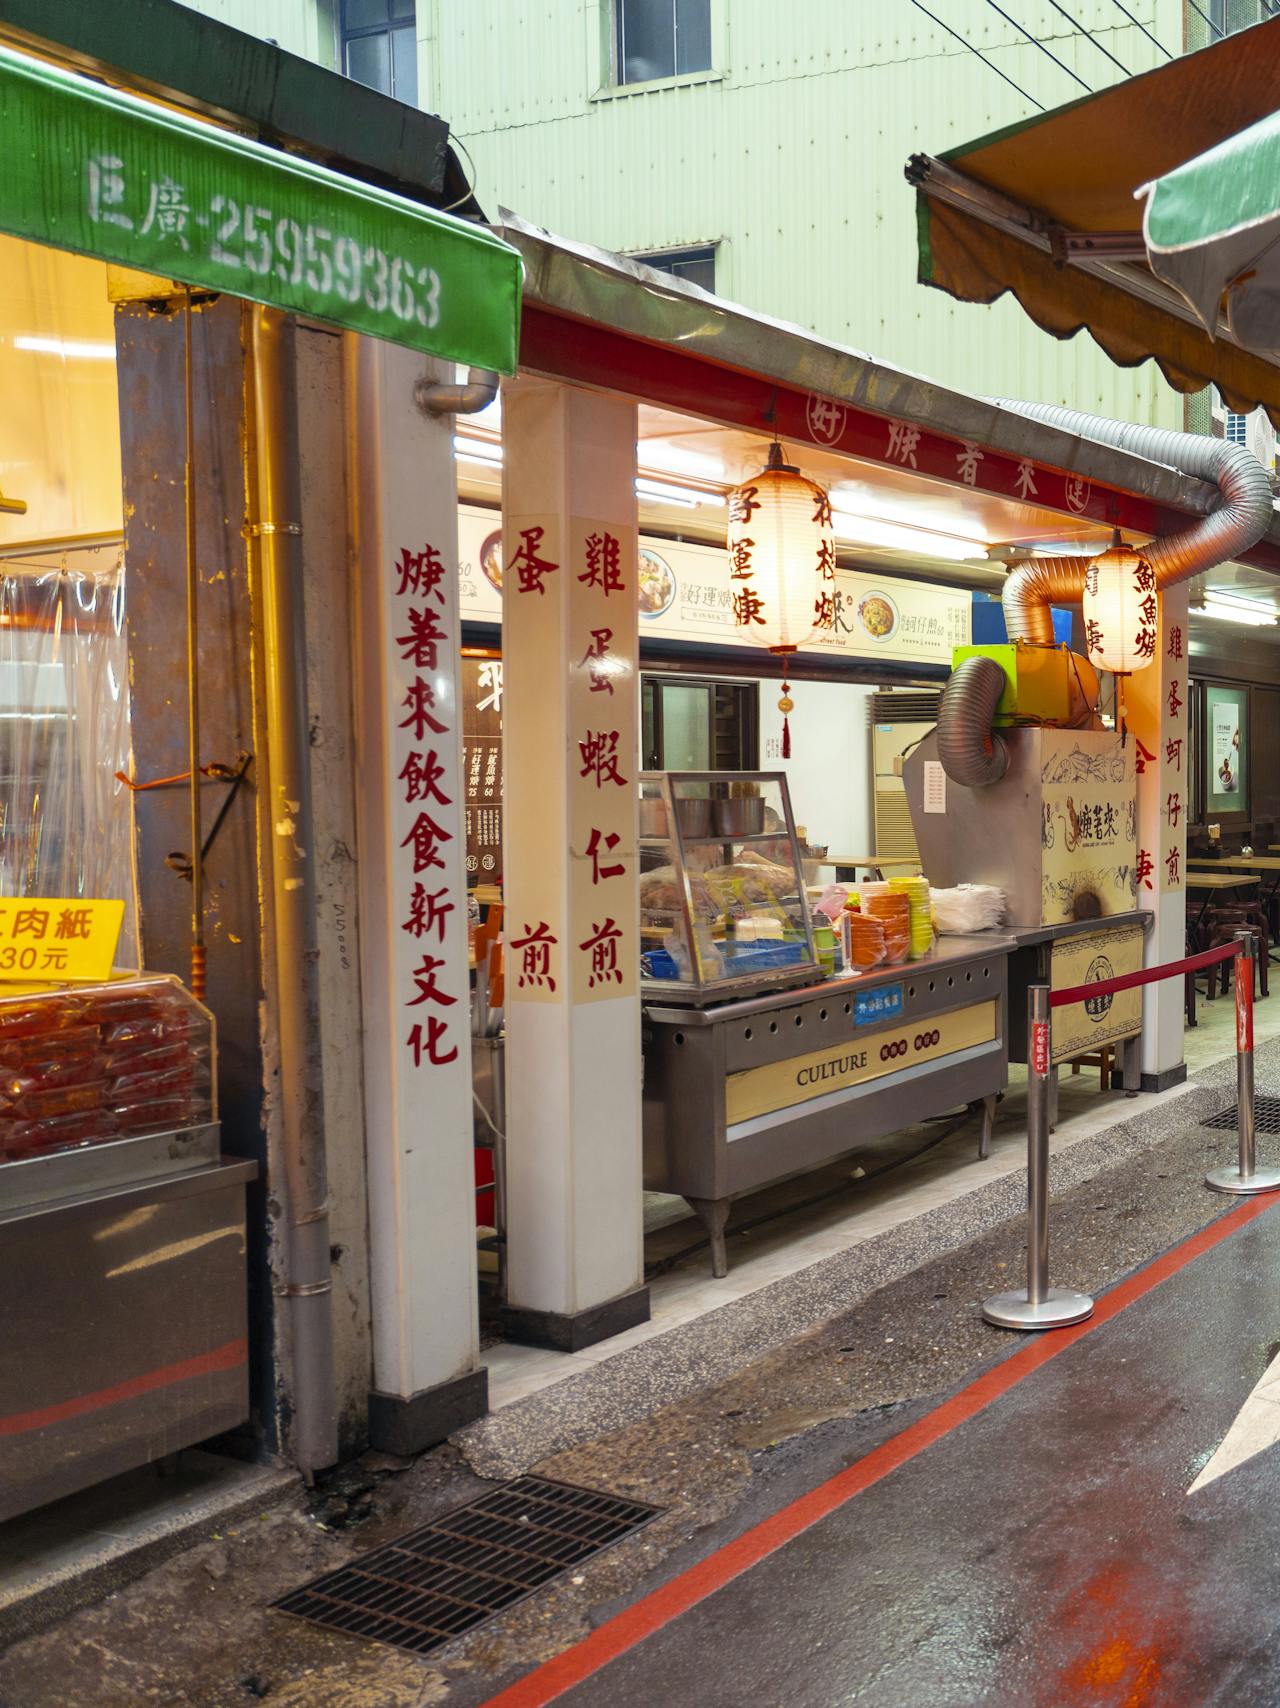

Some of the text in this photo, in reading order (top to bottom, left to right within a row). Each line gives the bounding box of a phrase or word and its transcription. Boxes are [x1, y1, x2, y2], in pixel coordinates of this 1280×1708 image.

[506, 526, 560, 992] 蛋 煎
[577, 531, 629, 988] 雞蛋蝦仁煎
[796, 1052, 867, 1086] CULTURE
